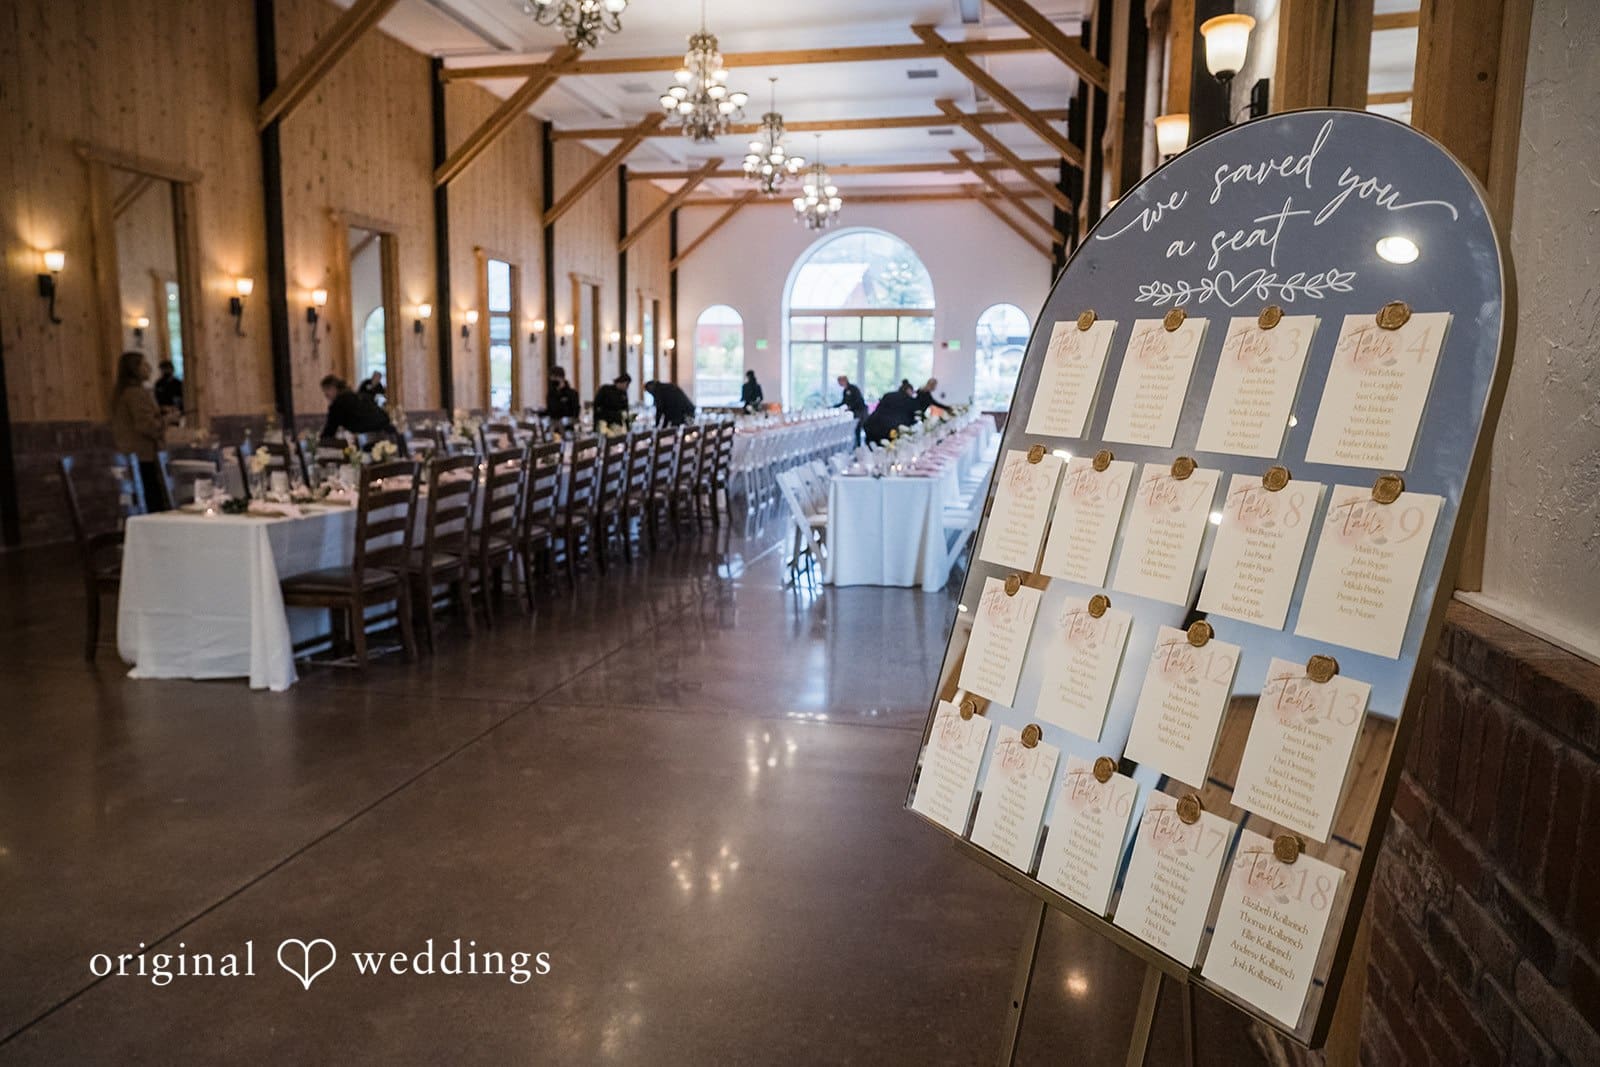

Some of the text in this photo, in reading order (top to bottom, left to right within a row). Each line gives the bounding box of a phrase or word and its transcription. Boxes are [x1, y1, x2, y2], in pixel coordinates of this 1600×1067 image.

[1096, 118, 1458, 240] we saved you
[1166, 196, 1311, 271] a seat
[1234, 327, 1301, 361] Table 3
[1349, 325, 1433, 364] Table 4
[1071, 466, 1123, 501] Table 6
[1146, 475, 1209, 512] Table 7
[1233, 486, 1305, 528] Table 8
[1337, 498, 1425, 544] Table 9
[1066, 611, 1095, 640] Table
[1160, 641, 1233, 685] Table 12
[1273, 675, 1360, 727] Table 13
[1069, 770, 1131, 818] Table 16
[1150, 807, 1225, 858] Table 17
[1243, 849, 1331, 911] Table 18
[1230, 939, 1259, 960] Andrew
